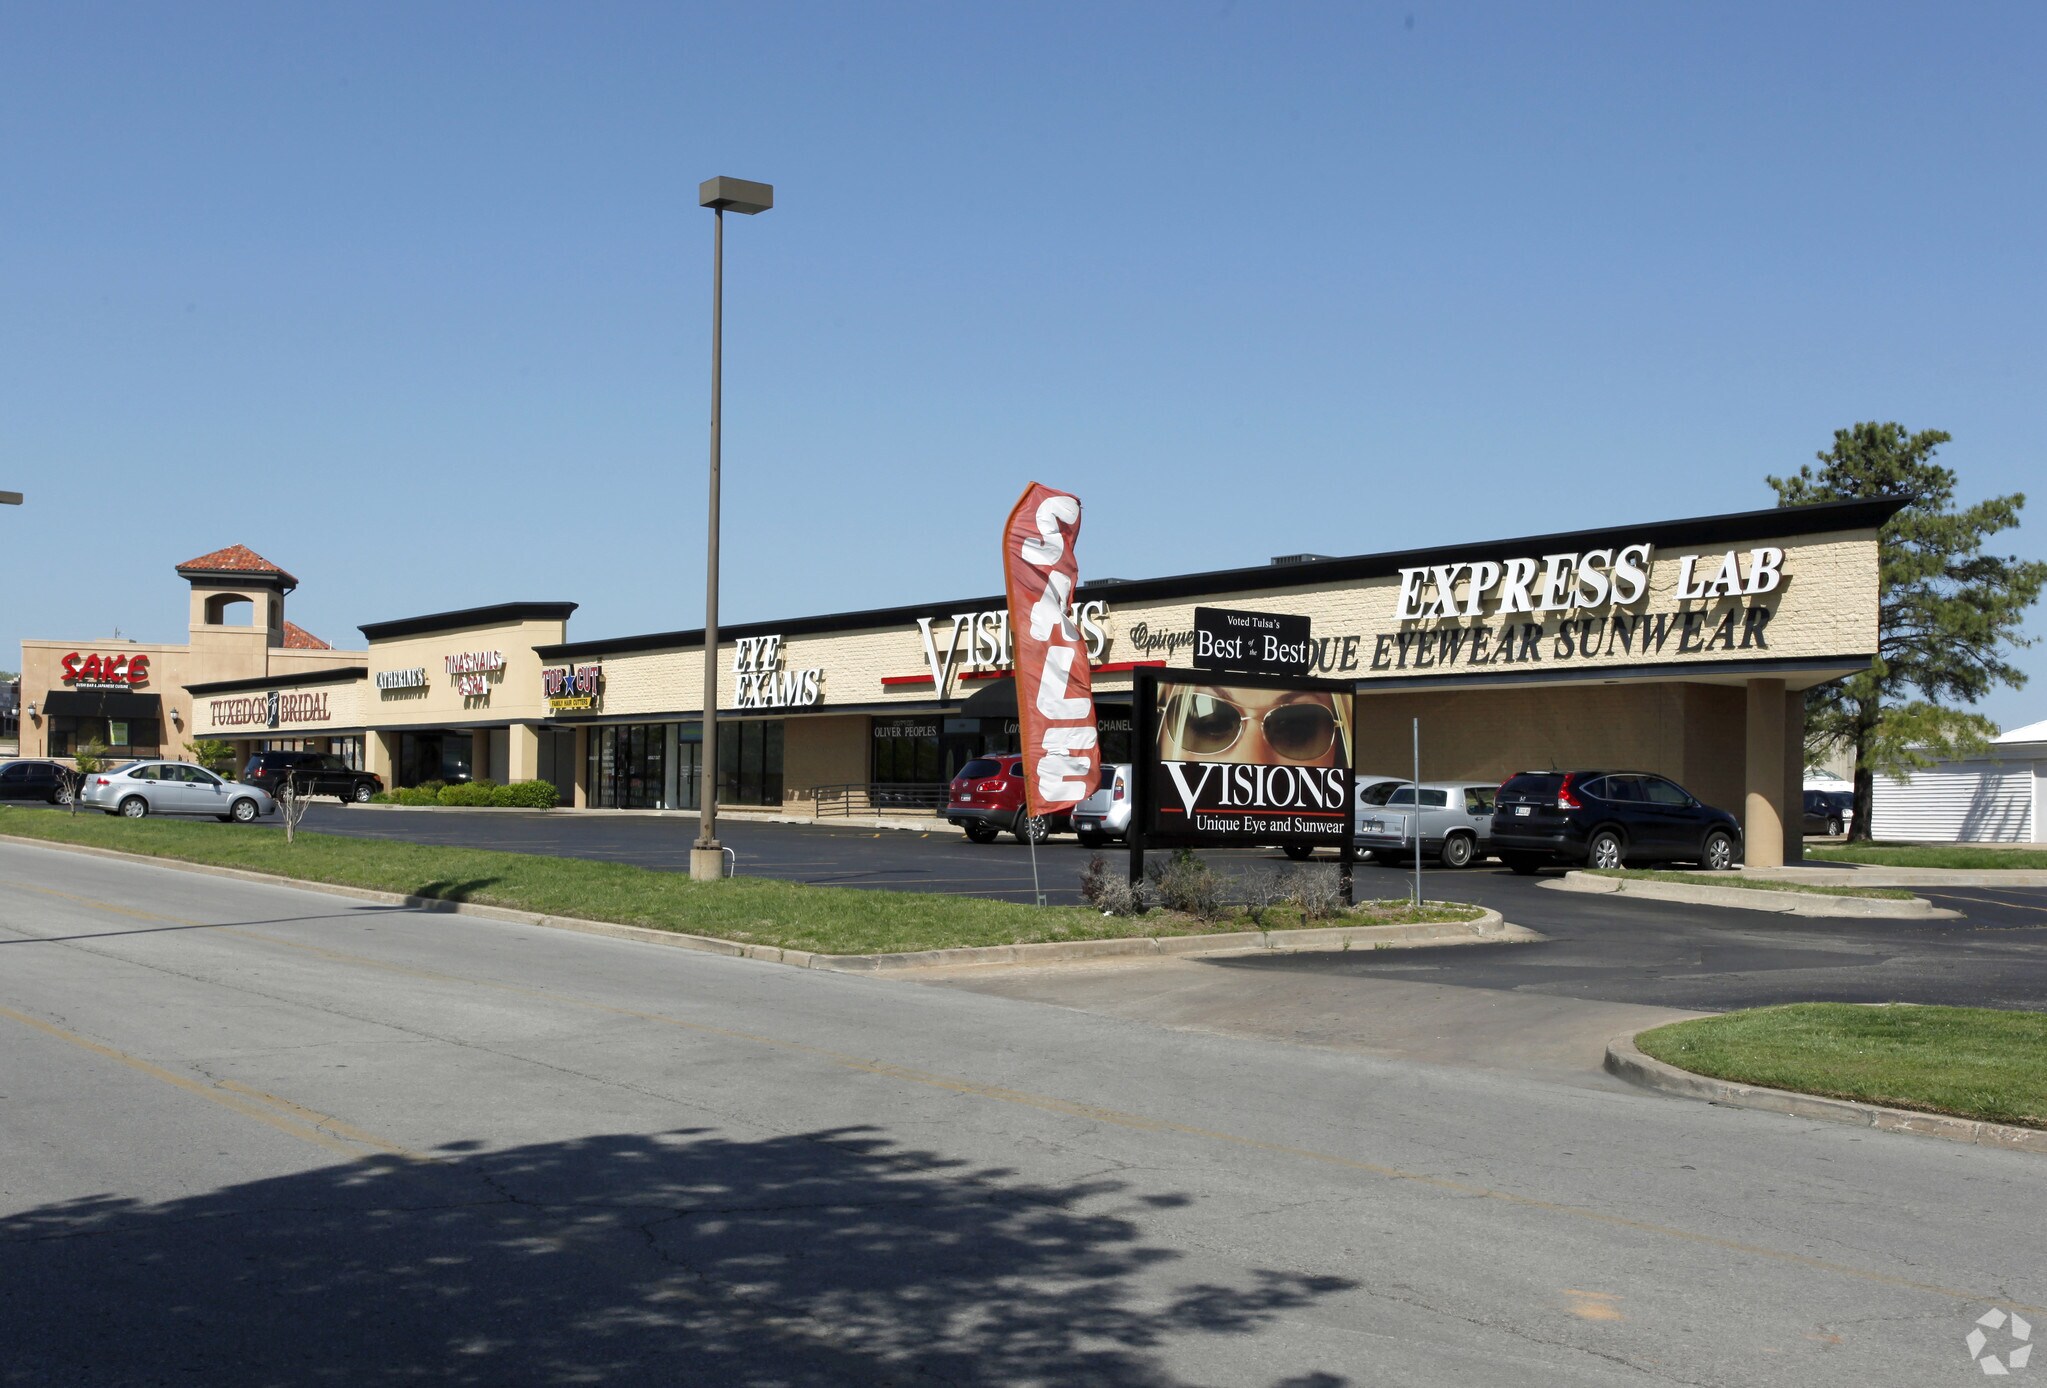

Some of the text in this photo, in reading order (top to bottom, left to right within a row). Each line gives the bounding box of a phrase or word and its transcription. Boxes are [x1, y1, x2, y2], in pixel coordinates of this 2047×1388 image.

[1393, 543, 1786, 621] EXPRESS LAB
[1227, 615, 1281, 629] Voted Tulsa's
[1370, 622, 1545, 669] EYEWEAR
[1553, 606, 1772, 660] SUNWEAR
[732, 634, 781, 672] EYE
[916, 600, 1107, 700] VISIS
[1022, 496, 1098, 802] SALE
[1130, 621, 1194, 660] Optique
[1197, 630, 1307, 664] Best of the Best
[60, 652, 149, 683] SAKE
[375, 667, 426, 690] CATHERINE'S
[444, 650, 502, 674] TINA'S NAILS
[542, 666, 599, 699] TOP CUT
[733, 668, 821, 709] EXAMS
[210, 692, 331, 726] TUXEDOS BRIDAL
[1097, 719, 1134, 731] CHANEL
[874, 725, 937, 738] OLIVER PEOPLES
[1161, 761, 1345, 819] VISIONS
[1196, 815, 1240, 833] Unique
[1244, 816, 1267, 834] Eye
[1270, 817, 1291, 832] and
[1294, 817, 1345, 834] Sunwear
